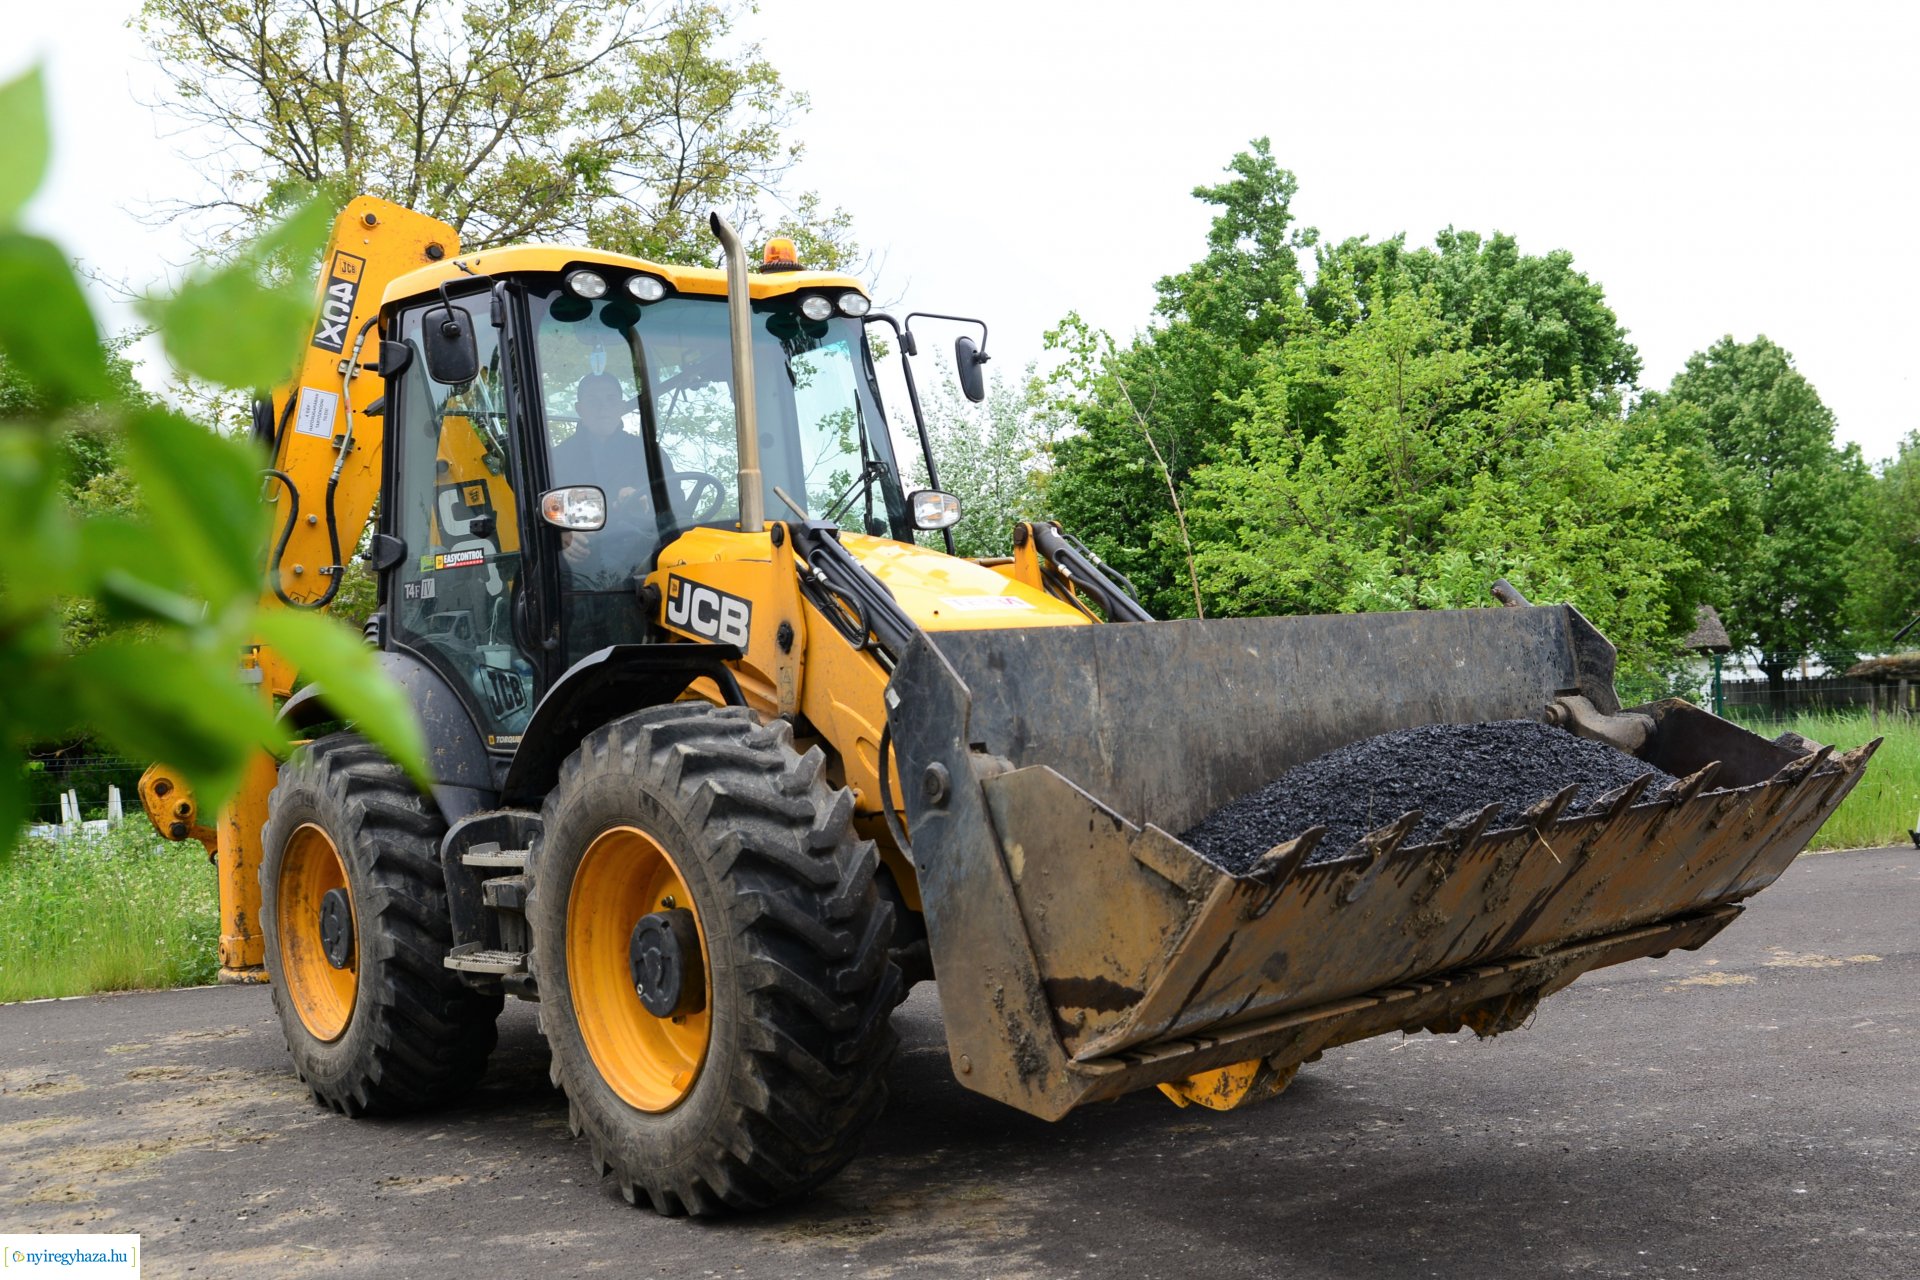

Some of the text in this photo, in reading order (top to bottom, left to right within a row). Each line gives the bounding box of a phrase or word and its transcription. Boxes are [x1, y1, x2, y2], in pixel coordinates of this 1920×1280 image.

[341, 261, 355, 274] JCB
[315, 282, 354, 345] 4CX
[443, 549, 484, 567] EASYCONTROL
[667, 582, 749, 647] JCB
[487, 670, 524, 716] JCB
